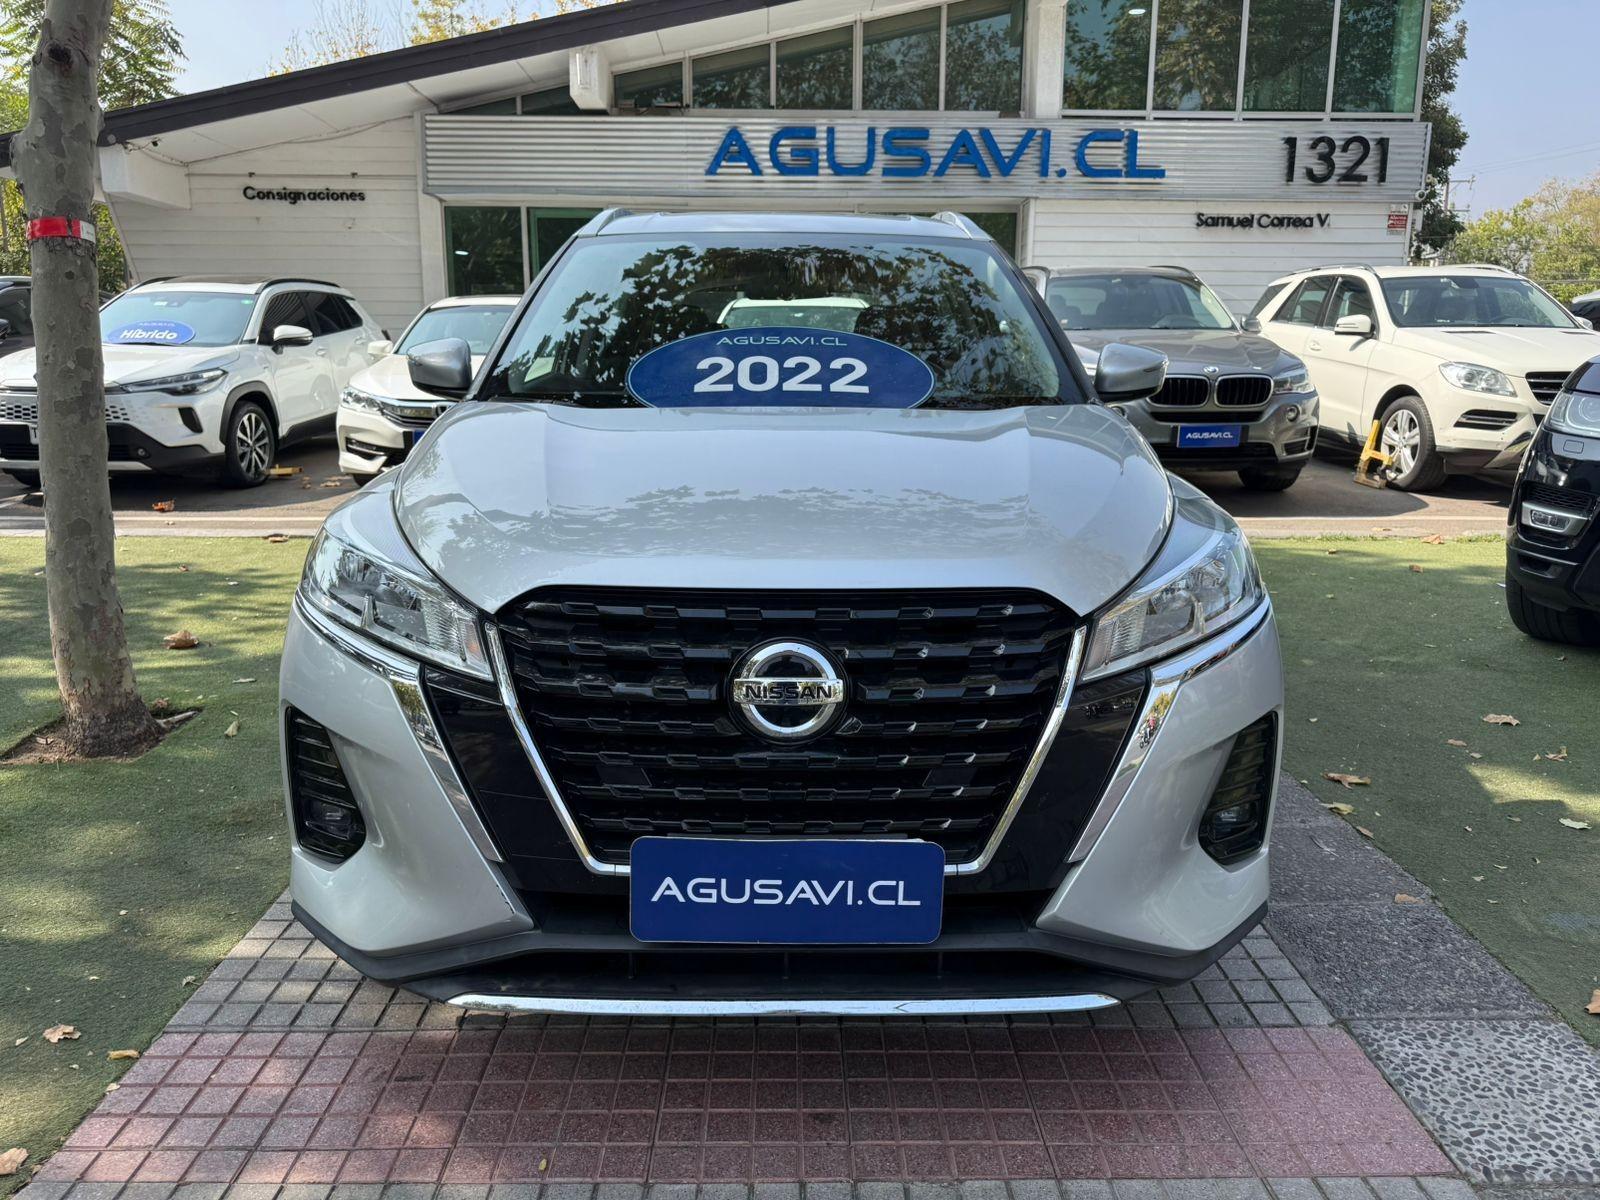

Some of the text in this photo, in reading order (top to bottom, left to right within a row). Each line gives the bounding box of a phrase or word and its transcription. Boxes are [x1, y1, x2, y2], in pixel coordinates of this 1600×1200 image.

[704, 126, 1166, 180] AGUSAVI.CL
[1282, 135, 1390, 184] 1321
[242, 186, 366, 205] Consignaciones
[1195, 212, 1255, 228] Samuel
[1257, 213, 1314, 228] Correa
[716, 336, 848, 346] AGUSAVI.CL
[693, 355, 870, 394] 2022
[1185, 431, 1234, 439] AGUSAVI.CL
[744, 685, 832, 699] NISSAN
[650, 876, 921, 906] AGUSAVI.CL
